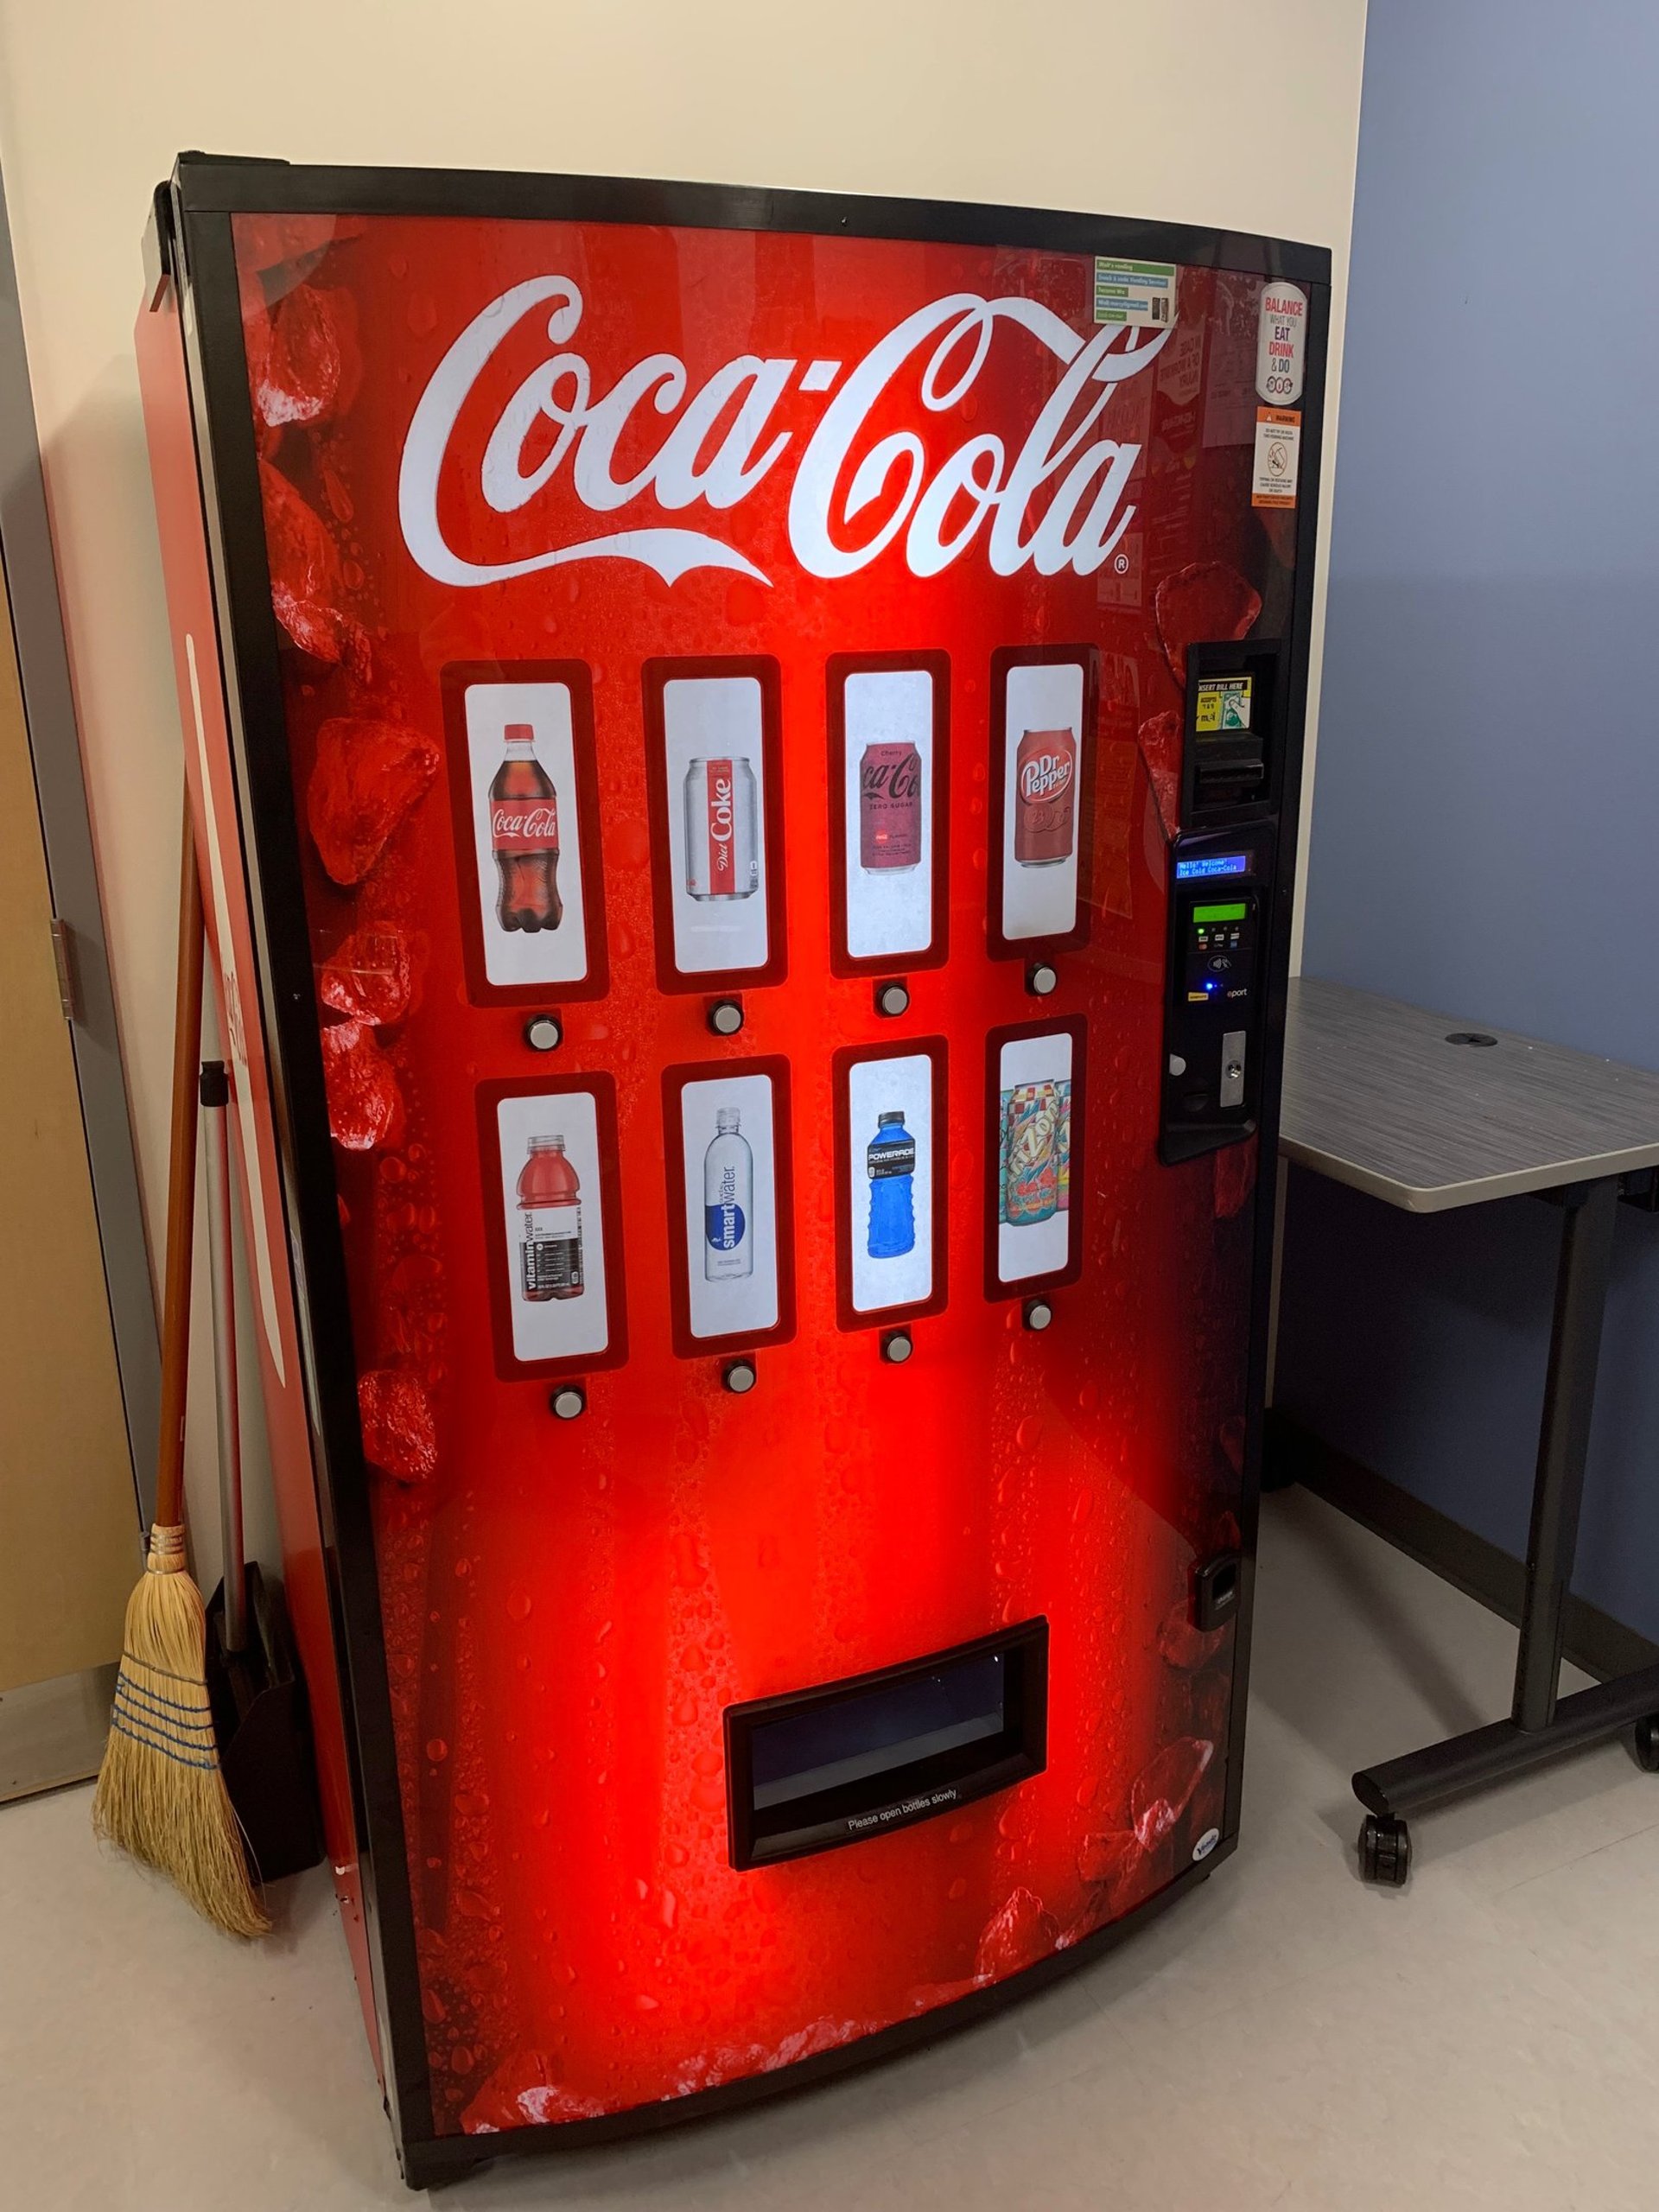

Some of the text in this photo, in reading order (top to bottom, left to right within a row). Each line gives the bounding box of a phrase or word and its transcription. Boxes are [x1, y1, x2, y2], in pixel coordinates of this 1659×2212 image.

[1265, 297, 1303, 316] BALANCE
[1270, 314, 1297, 327] WHAT YOU
[1274, 326, 1291, 342] EAT
[1268, 341, 1294, 359] DRINK
[1271, 358, 1290, 373] & DO
[397, 274, 1179, 588] Coca-Cola
[1229, 682, 1243, 690] HERE
[1039, 754, 1060, 773] Dr
[1024, 760, 1070, 798] Pepper
[710, 778, 733, 842] Coke
[493, 808, 556, 838] Coca-Cola
[718, 843, 728, 872] Diet
[1208, 864, 1237, 873] Coca-Cola
[1227, 988, 1247, 997] eport
[868, 1147, 914, 1161] POWERADE
[721, 1166, 735, 1249] smartwater
[524, 1212, 537, 1289] vitaminwater
[848, 1789, 957, 1830] Please open bottles slowly
